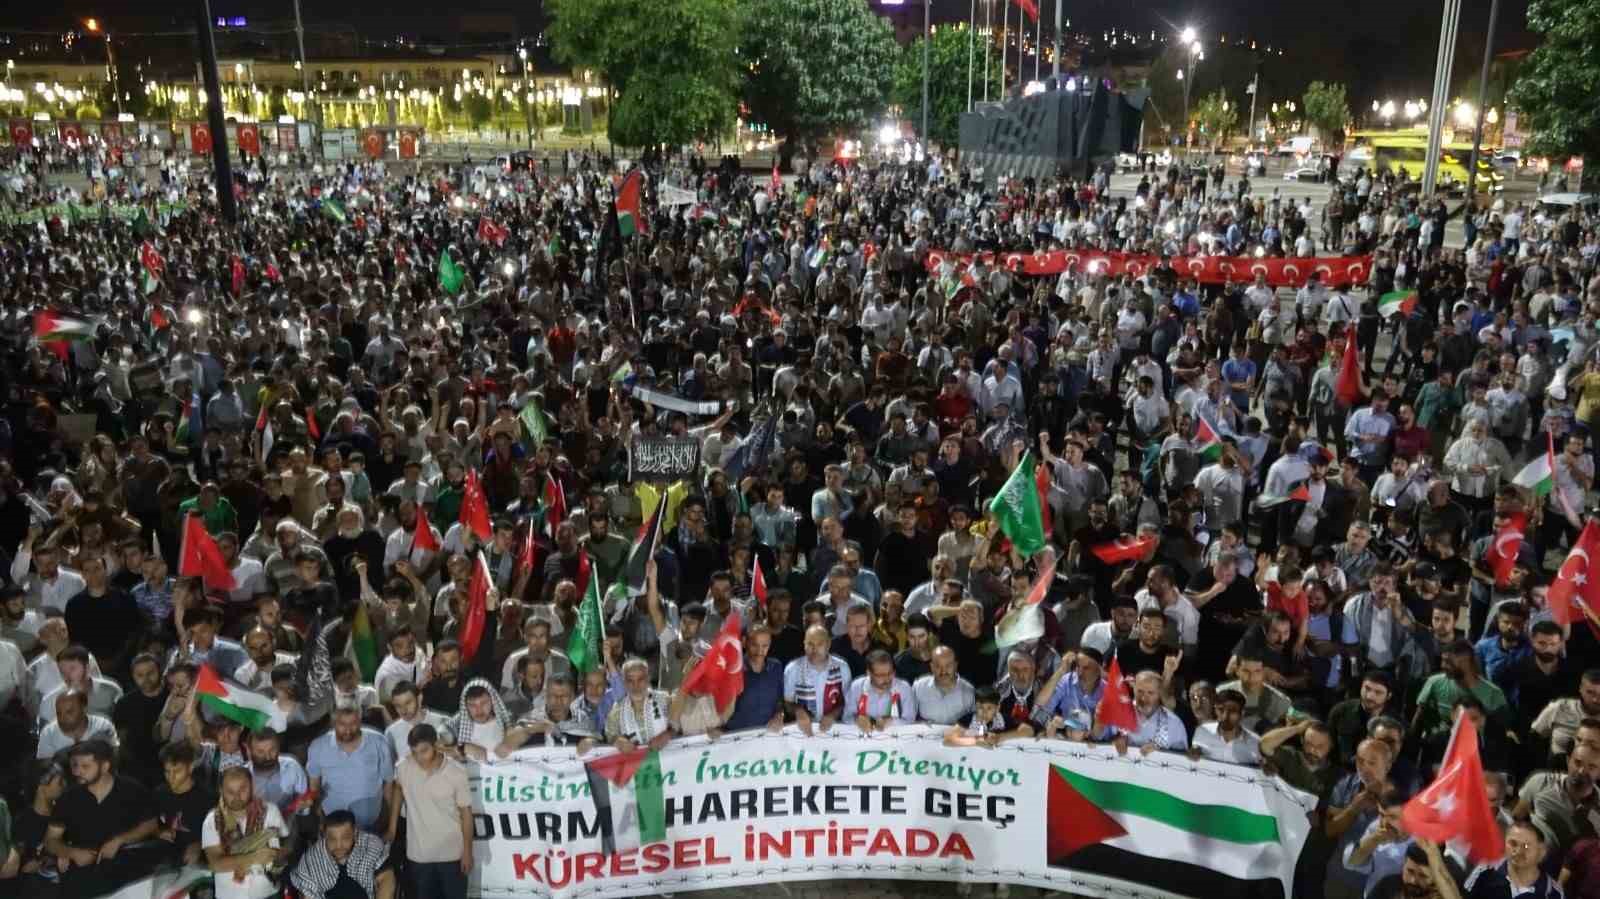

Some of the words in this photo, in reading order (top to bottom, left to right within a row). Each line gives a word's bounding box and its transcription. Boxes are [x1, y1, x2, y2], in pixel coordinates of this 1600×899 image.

[695, 750, 837, 784] İnsanlık
[855, 750, 1021, 791] Direniyor
[472, 801, 647, 844] DURMA
[665, 785, 907, 828] HAREKETE
[924, 787, 1016, 830] GEÇ
[512, 836, 731, 890] KÜRESEL
[744, 820, 975, 861] İNTİFADA
